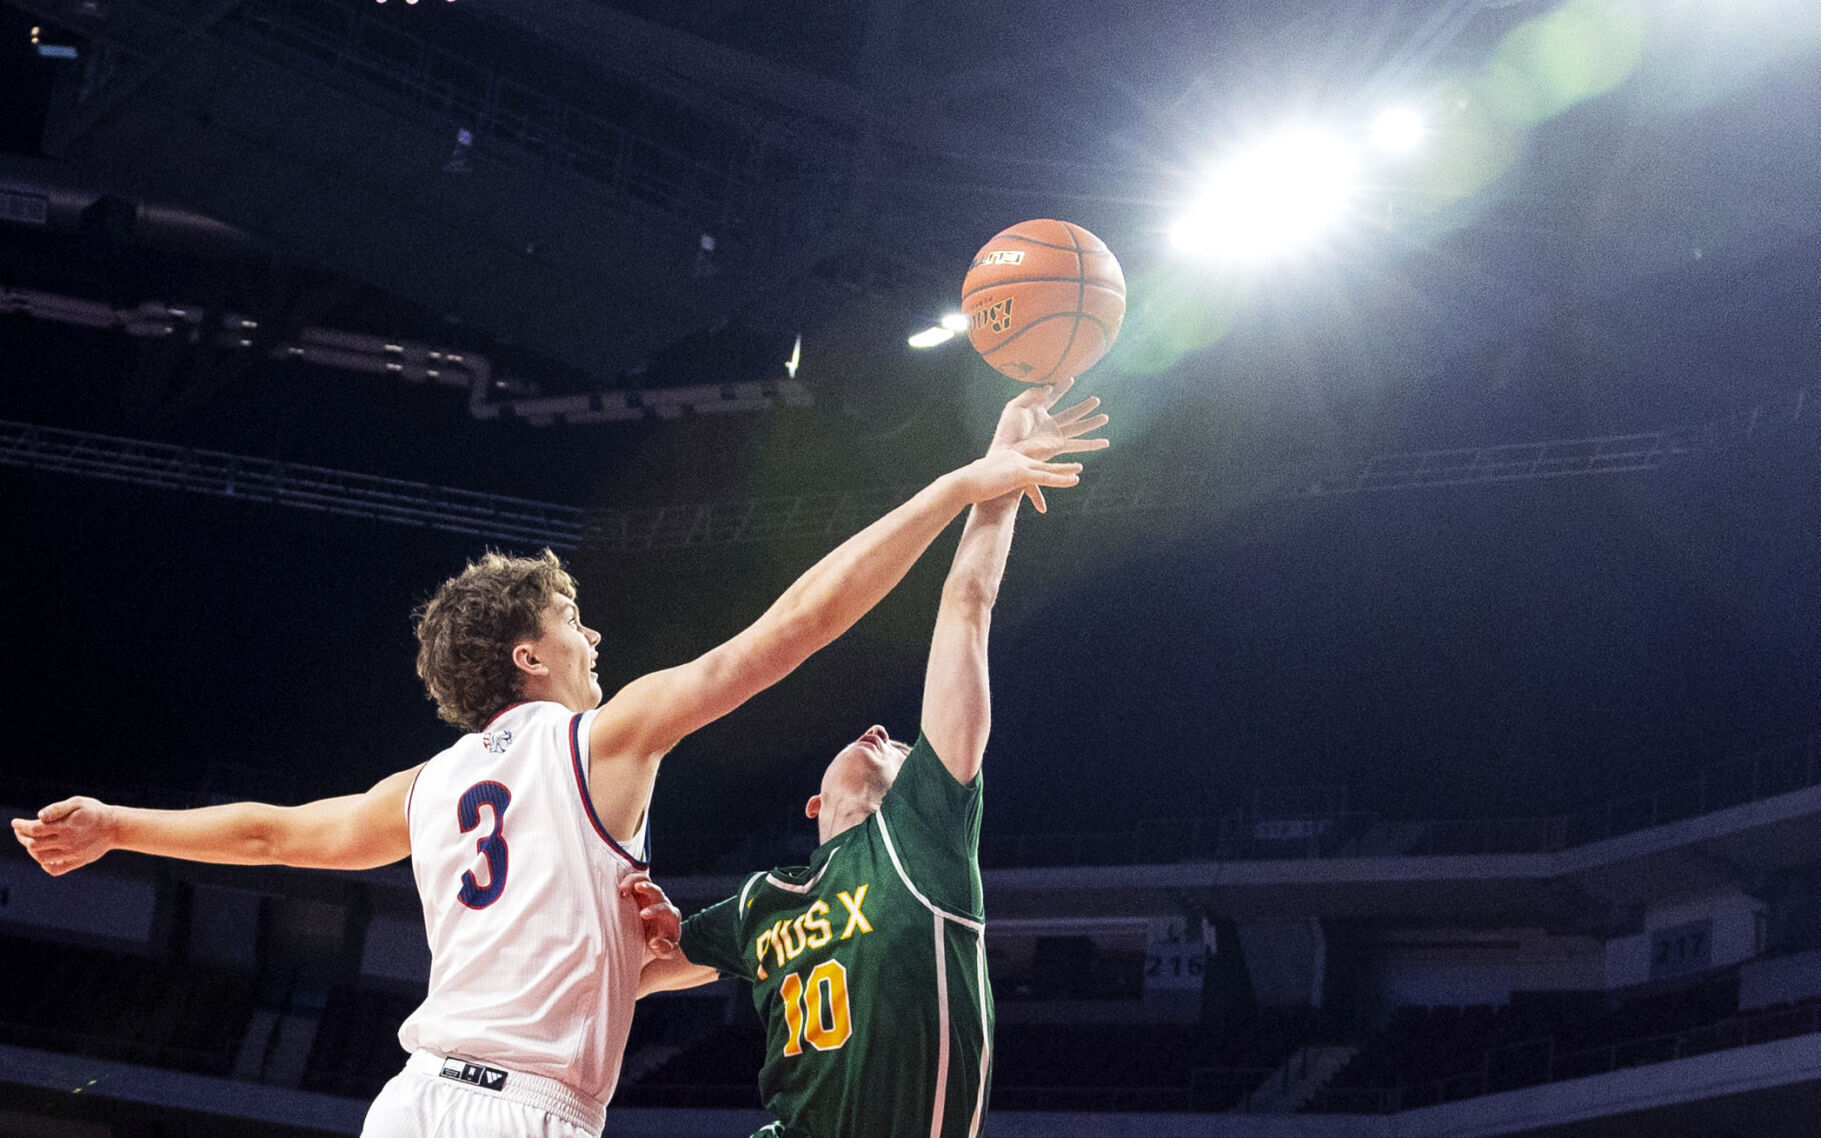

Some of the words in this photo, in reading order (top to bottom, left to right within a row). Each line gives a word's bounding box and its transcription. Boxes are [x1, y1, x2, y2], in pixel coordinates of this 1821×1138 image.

[457, 780, 511, 910] 3
[756, 899, 833, 981] PIUS
[836, 884, 874, 940] X
[1143, 954, 1203, 977] 216
[780, 959, 853, 1057] 10
